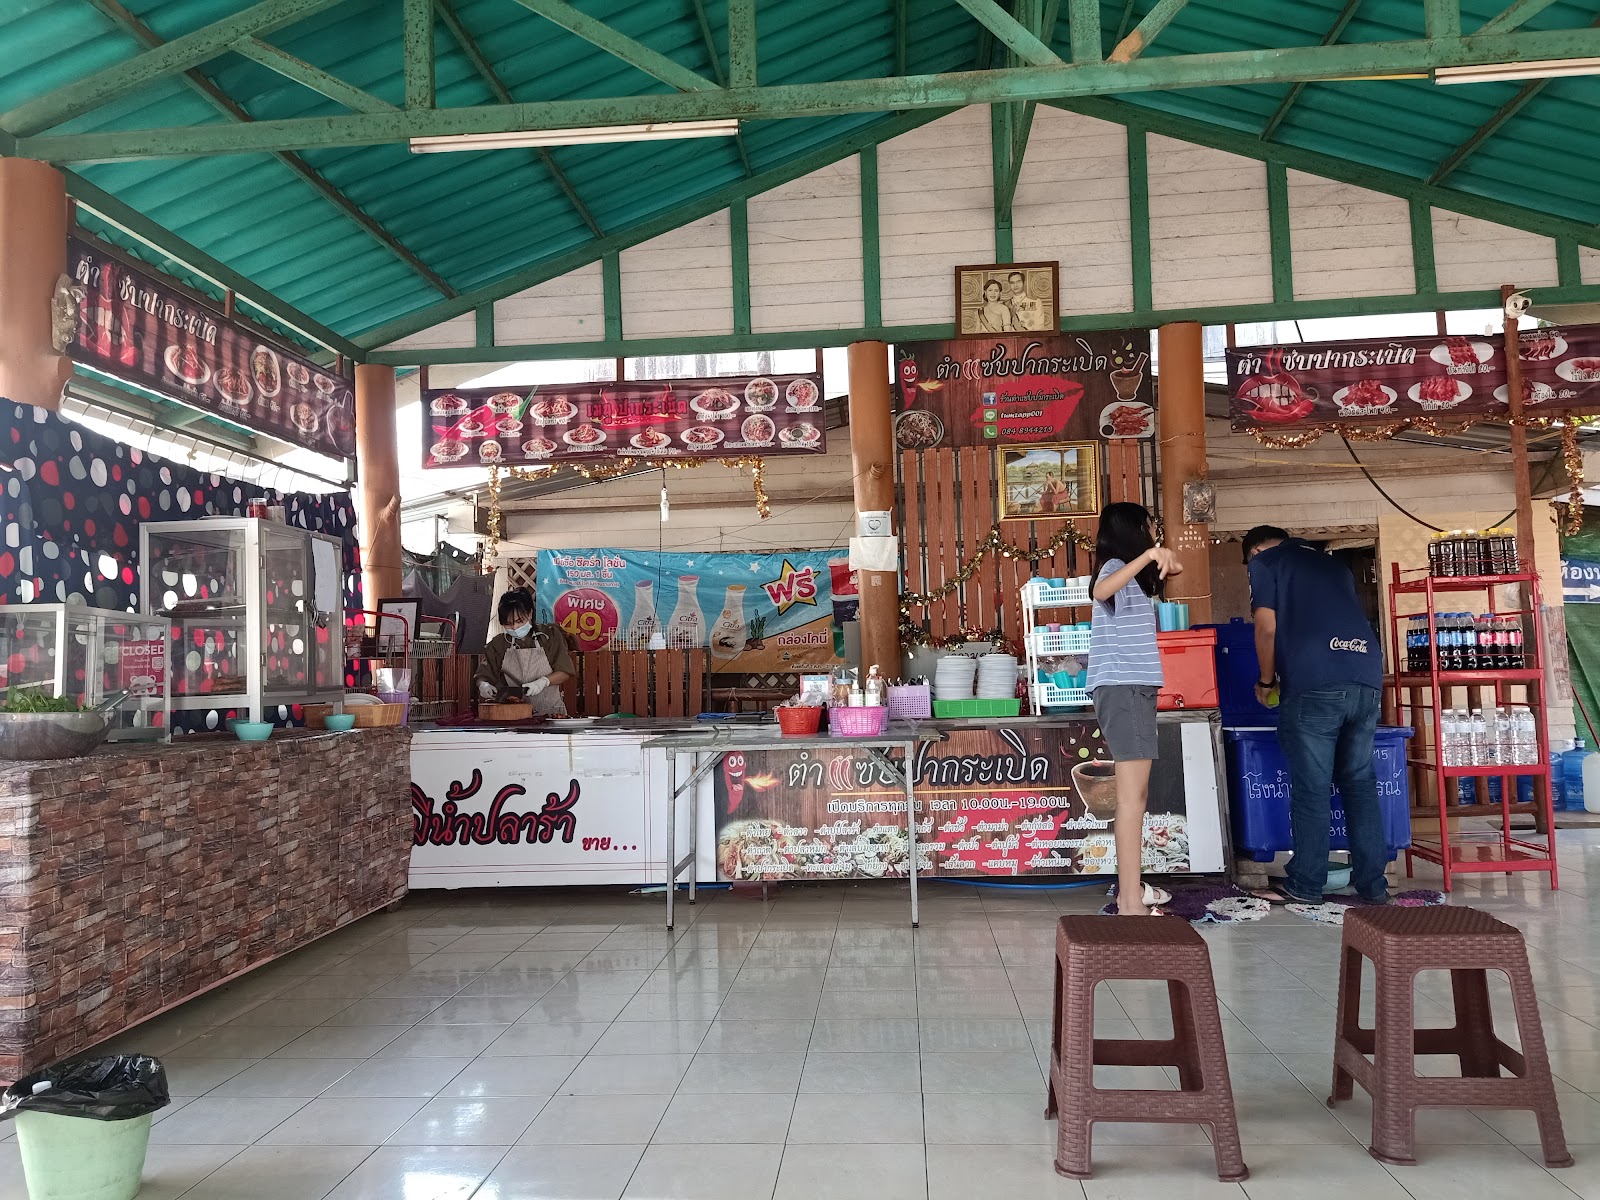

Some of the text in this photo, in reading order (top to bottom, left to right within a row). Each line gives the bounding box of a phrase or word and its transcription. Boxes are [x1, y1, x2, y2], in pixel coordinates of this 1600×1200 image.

[566, 570, 580, 578] 150
[766, 567, 816, 605] ฟรี
[567, 594, 606, 610] พิเศษ
[679, 614, 698, 623] Citra
[722, 621, 740, 629] Citra
[777, 631, 828, 646] กล่องโคนี่
[1330, 636, 1368, 653] Coca-Cola
[122, 645, 164, 656] CLOSED
[930, 798, 958, 812] เวลา
